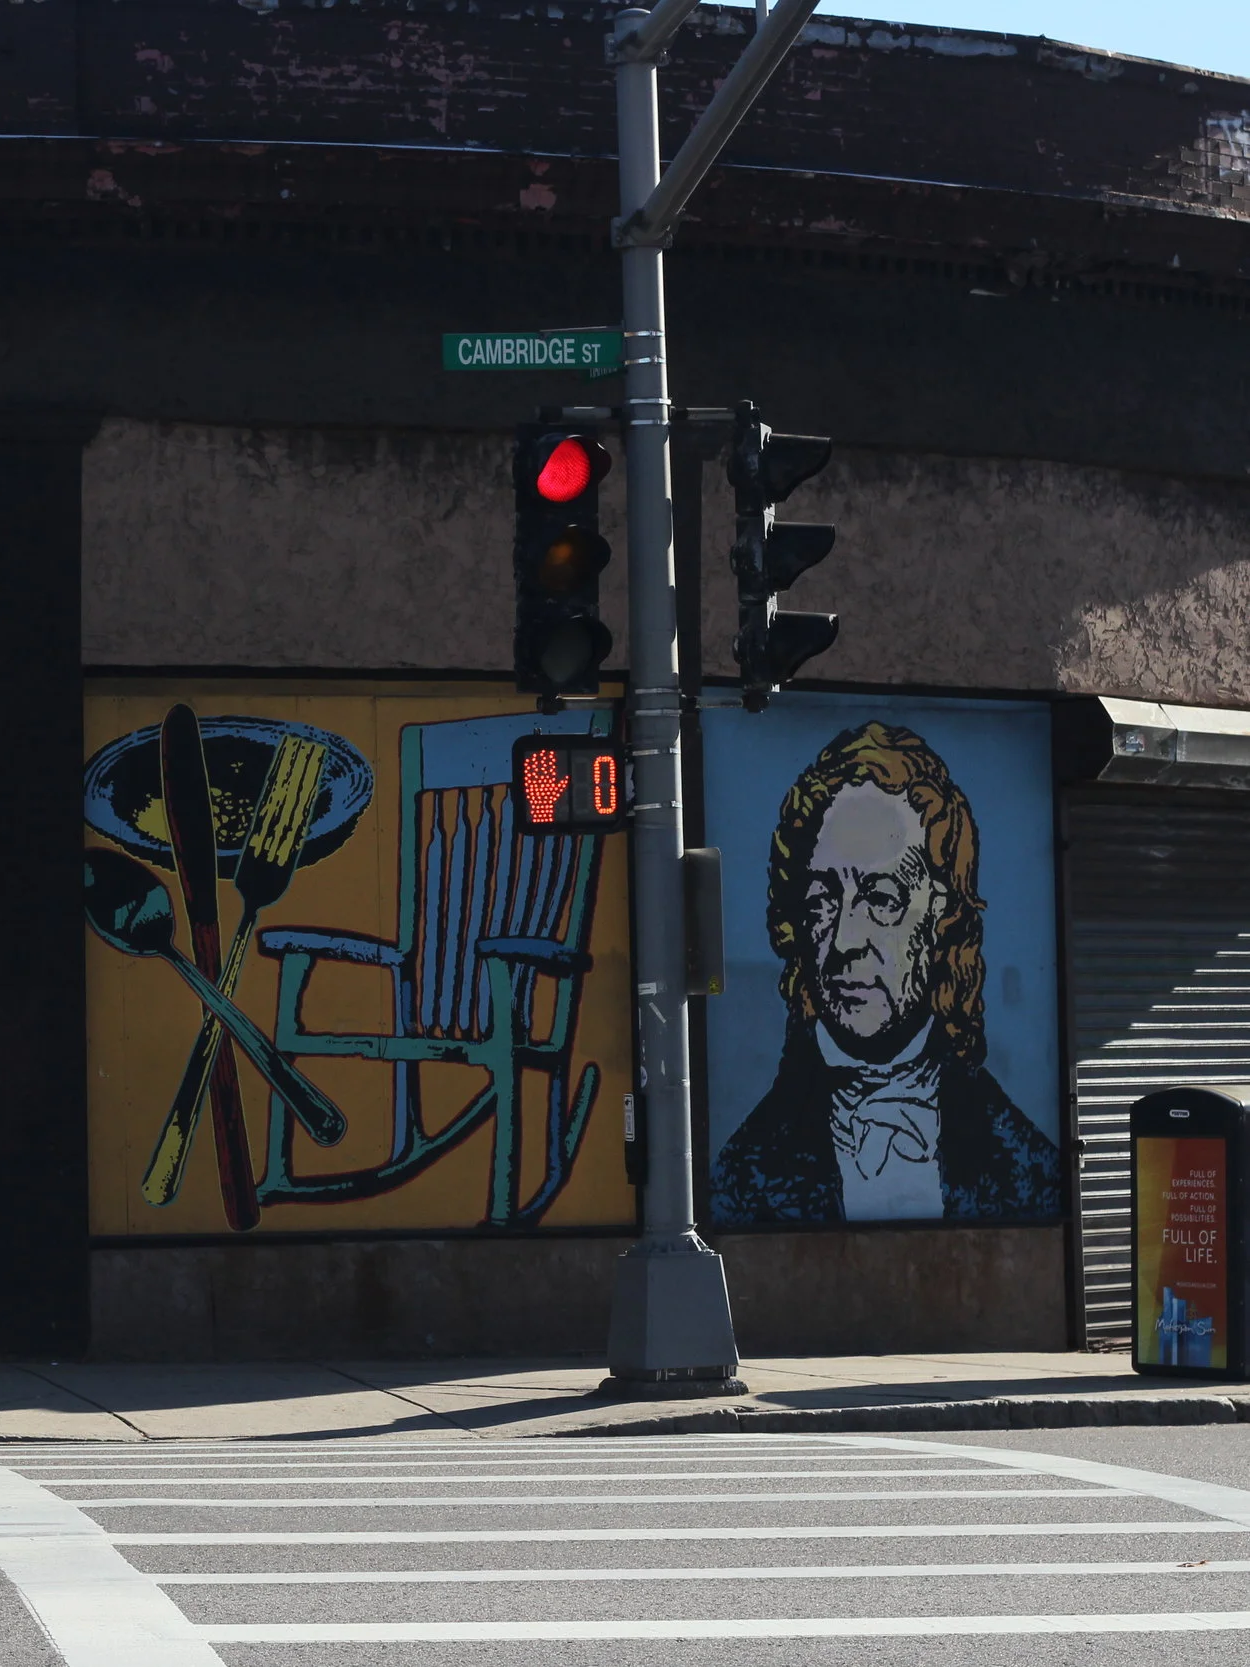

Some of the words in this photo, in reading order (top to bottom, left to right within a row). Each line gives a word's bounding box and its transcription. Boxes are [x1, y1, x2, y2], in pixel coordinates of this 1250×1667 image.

[458, 338, 575, 365] CAMBRIDGE
[581, 343, 601, 363] ST
[594, 755, 617, 814] 0
[1189, 1169, 1205, 1178] FULL
[1207, 1170, 1216, 1178] OF
[1162, 1191, 1177, 1200] FULL
[1179, 1192, 1188, 1200] OF
[1190, 1205, 1205, 1213] FULL
[1207, 1205, 1216, 1213] OF
[1162, 1228, 1195, 1244] FULL
[1199, 1230, 1217, 1245] OF
[1186, 1247, 1217, 1264] LIFE.
